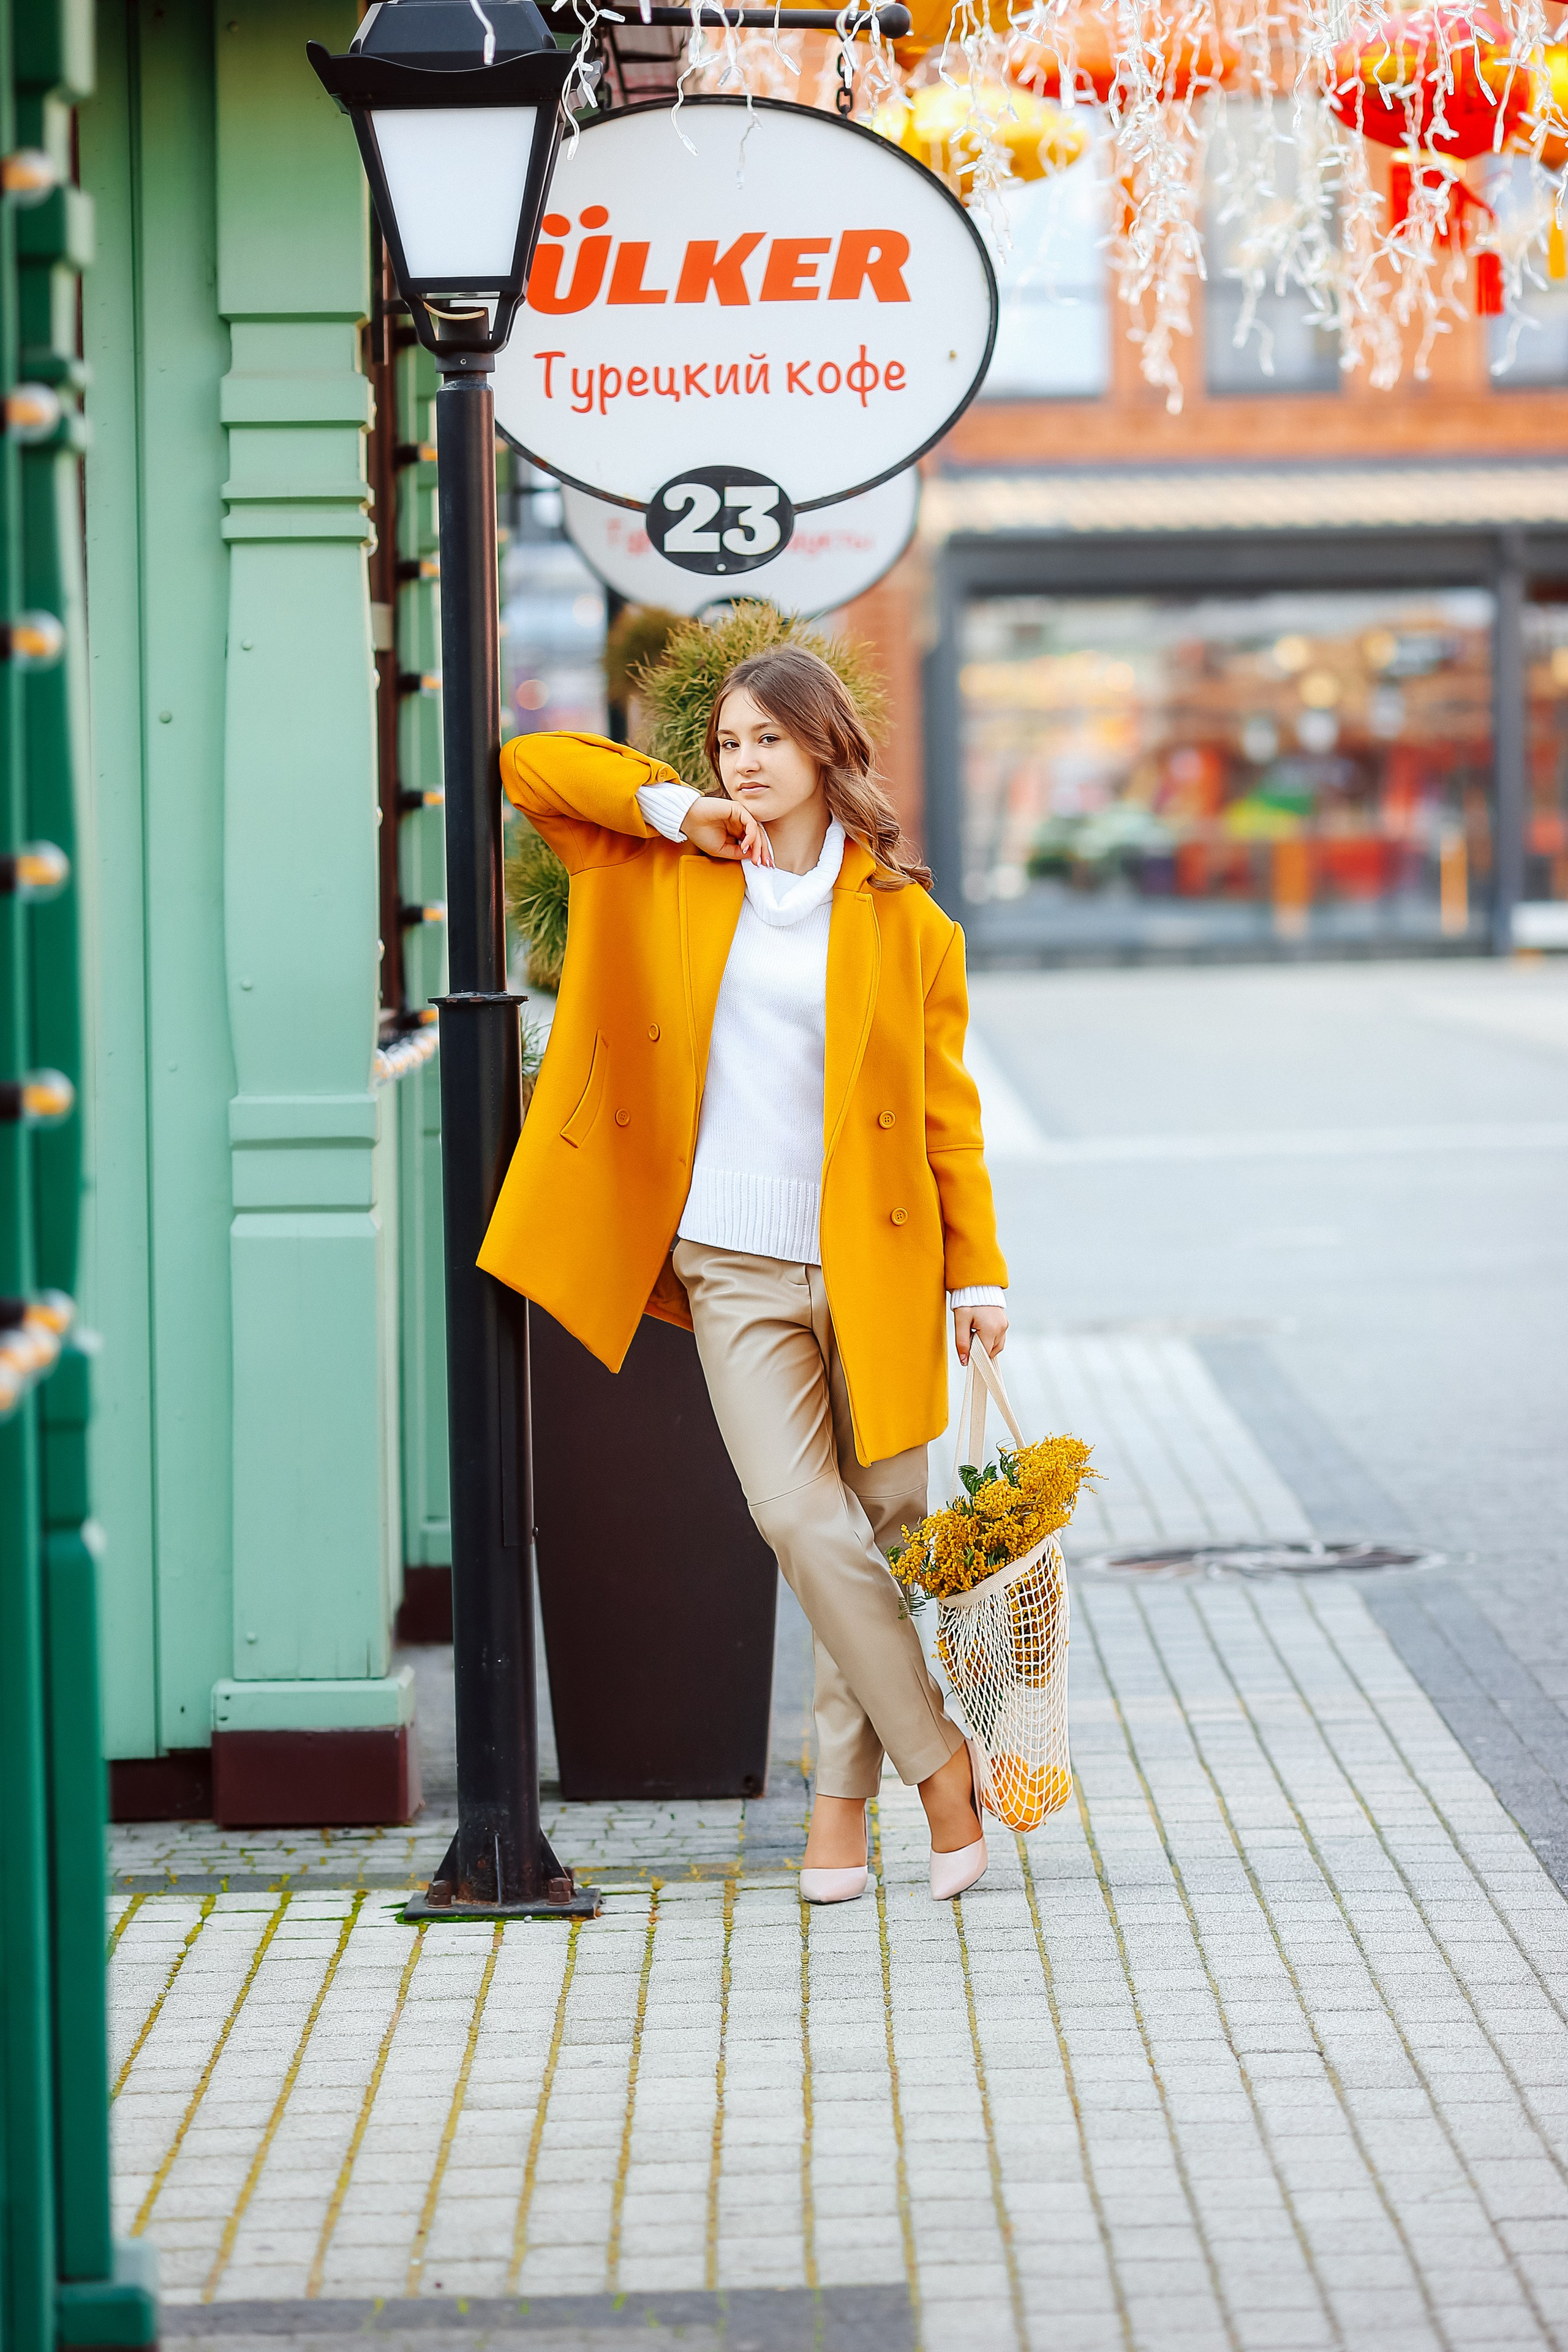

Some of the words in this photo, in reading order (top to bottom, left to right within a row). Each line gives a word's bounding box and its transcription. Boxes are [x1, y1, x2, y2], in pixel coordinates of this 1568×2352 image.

[526, 205, 910, 315] ÜLKER
[534, 351, 769, 415] Турецкий
[787, 345, 906, 407] кофе
[663, 483, 781, 556] 23
